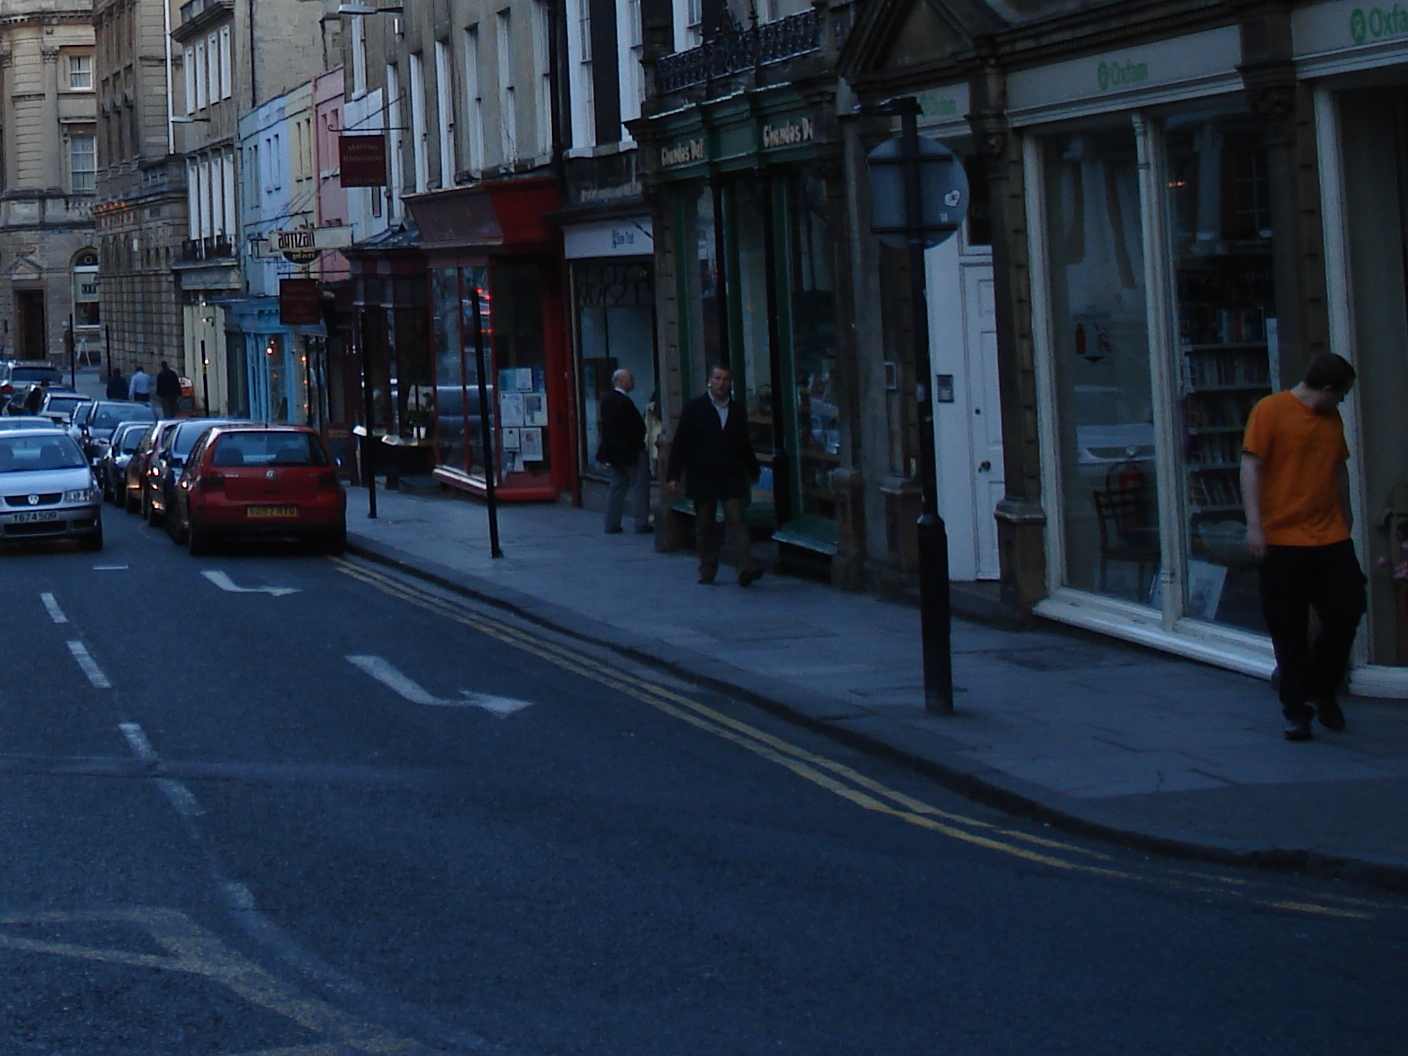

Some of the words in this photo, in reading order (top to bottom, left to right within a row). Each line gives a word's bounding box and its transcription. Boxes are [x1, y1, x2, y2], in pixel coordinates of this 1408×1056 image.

[1110, 59, 1149, 86] Oxfam
[763, 120, 801, 148] Chandos
[278, 231, 315, 249] artizan
